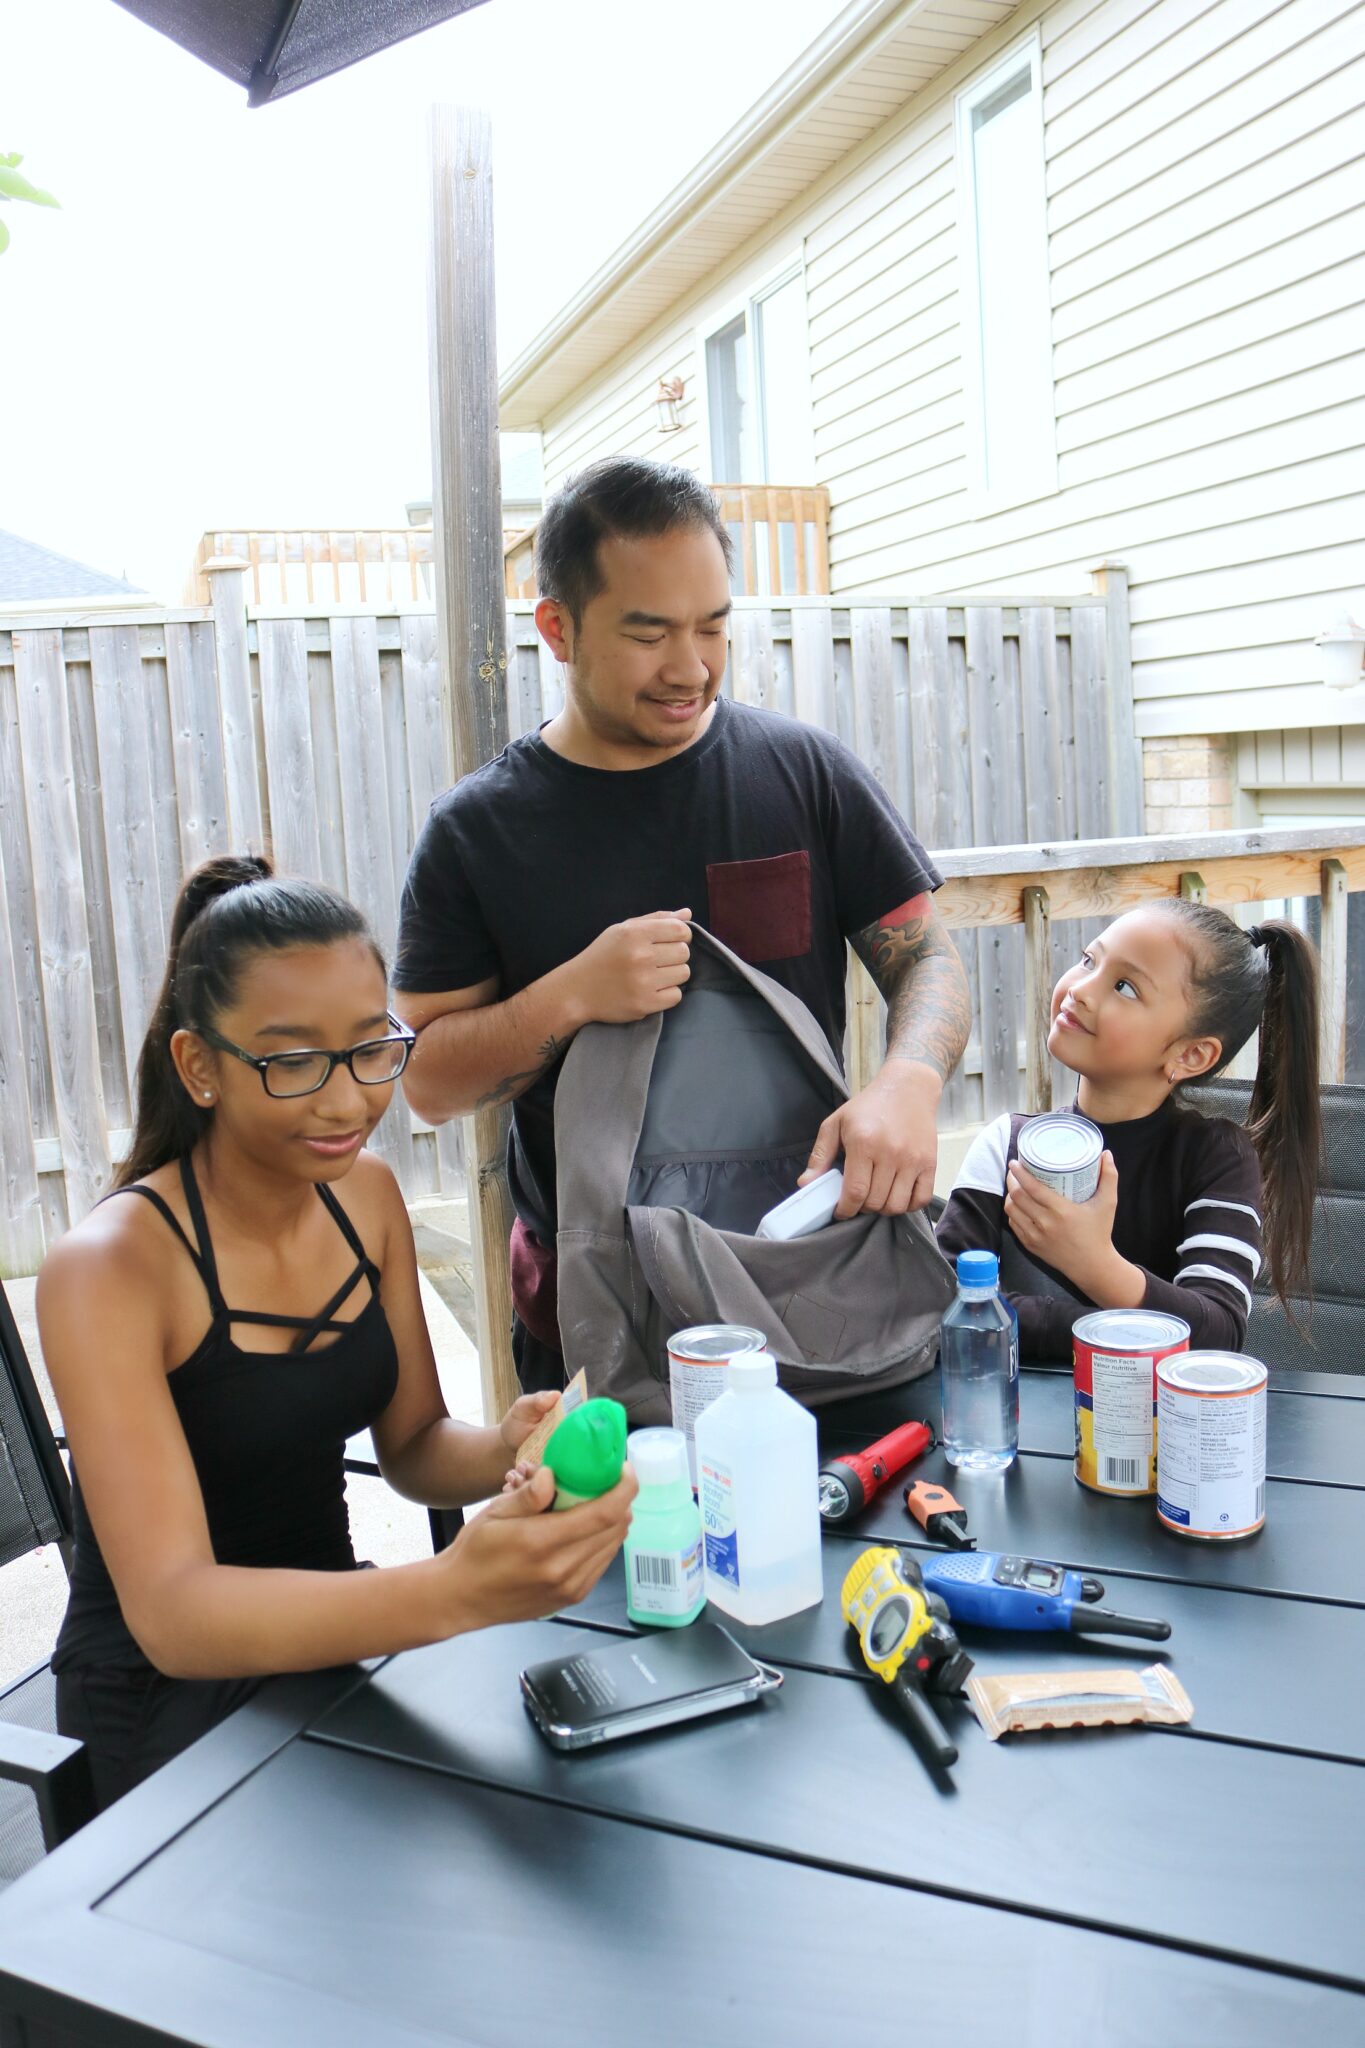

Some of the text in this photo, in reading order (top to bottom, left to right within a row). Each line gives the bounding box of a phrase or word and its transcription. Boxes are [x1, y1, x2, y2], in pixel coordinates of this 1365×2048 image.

[1093, 1354, 1118, 1364] Nutrition
[1093, 1361, 1138, 1372] Valeur nutritive
